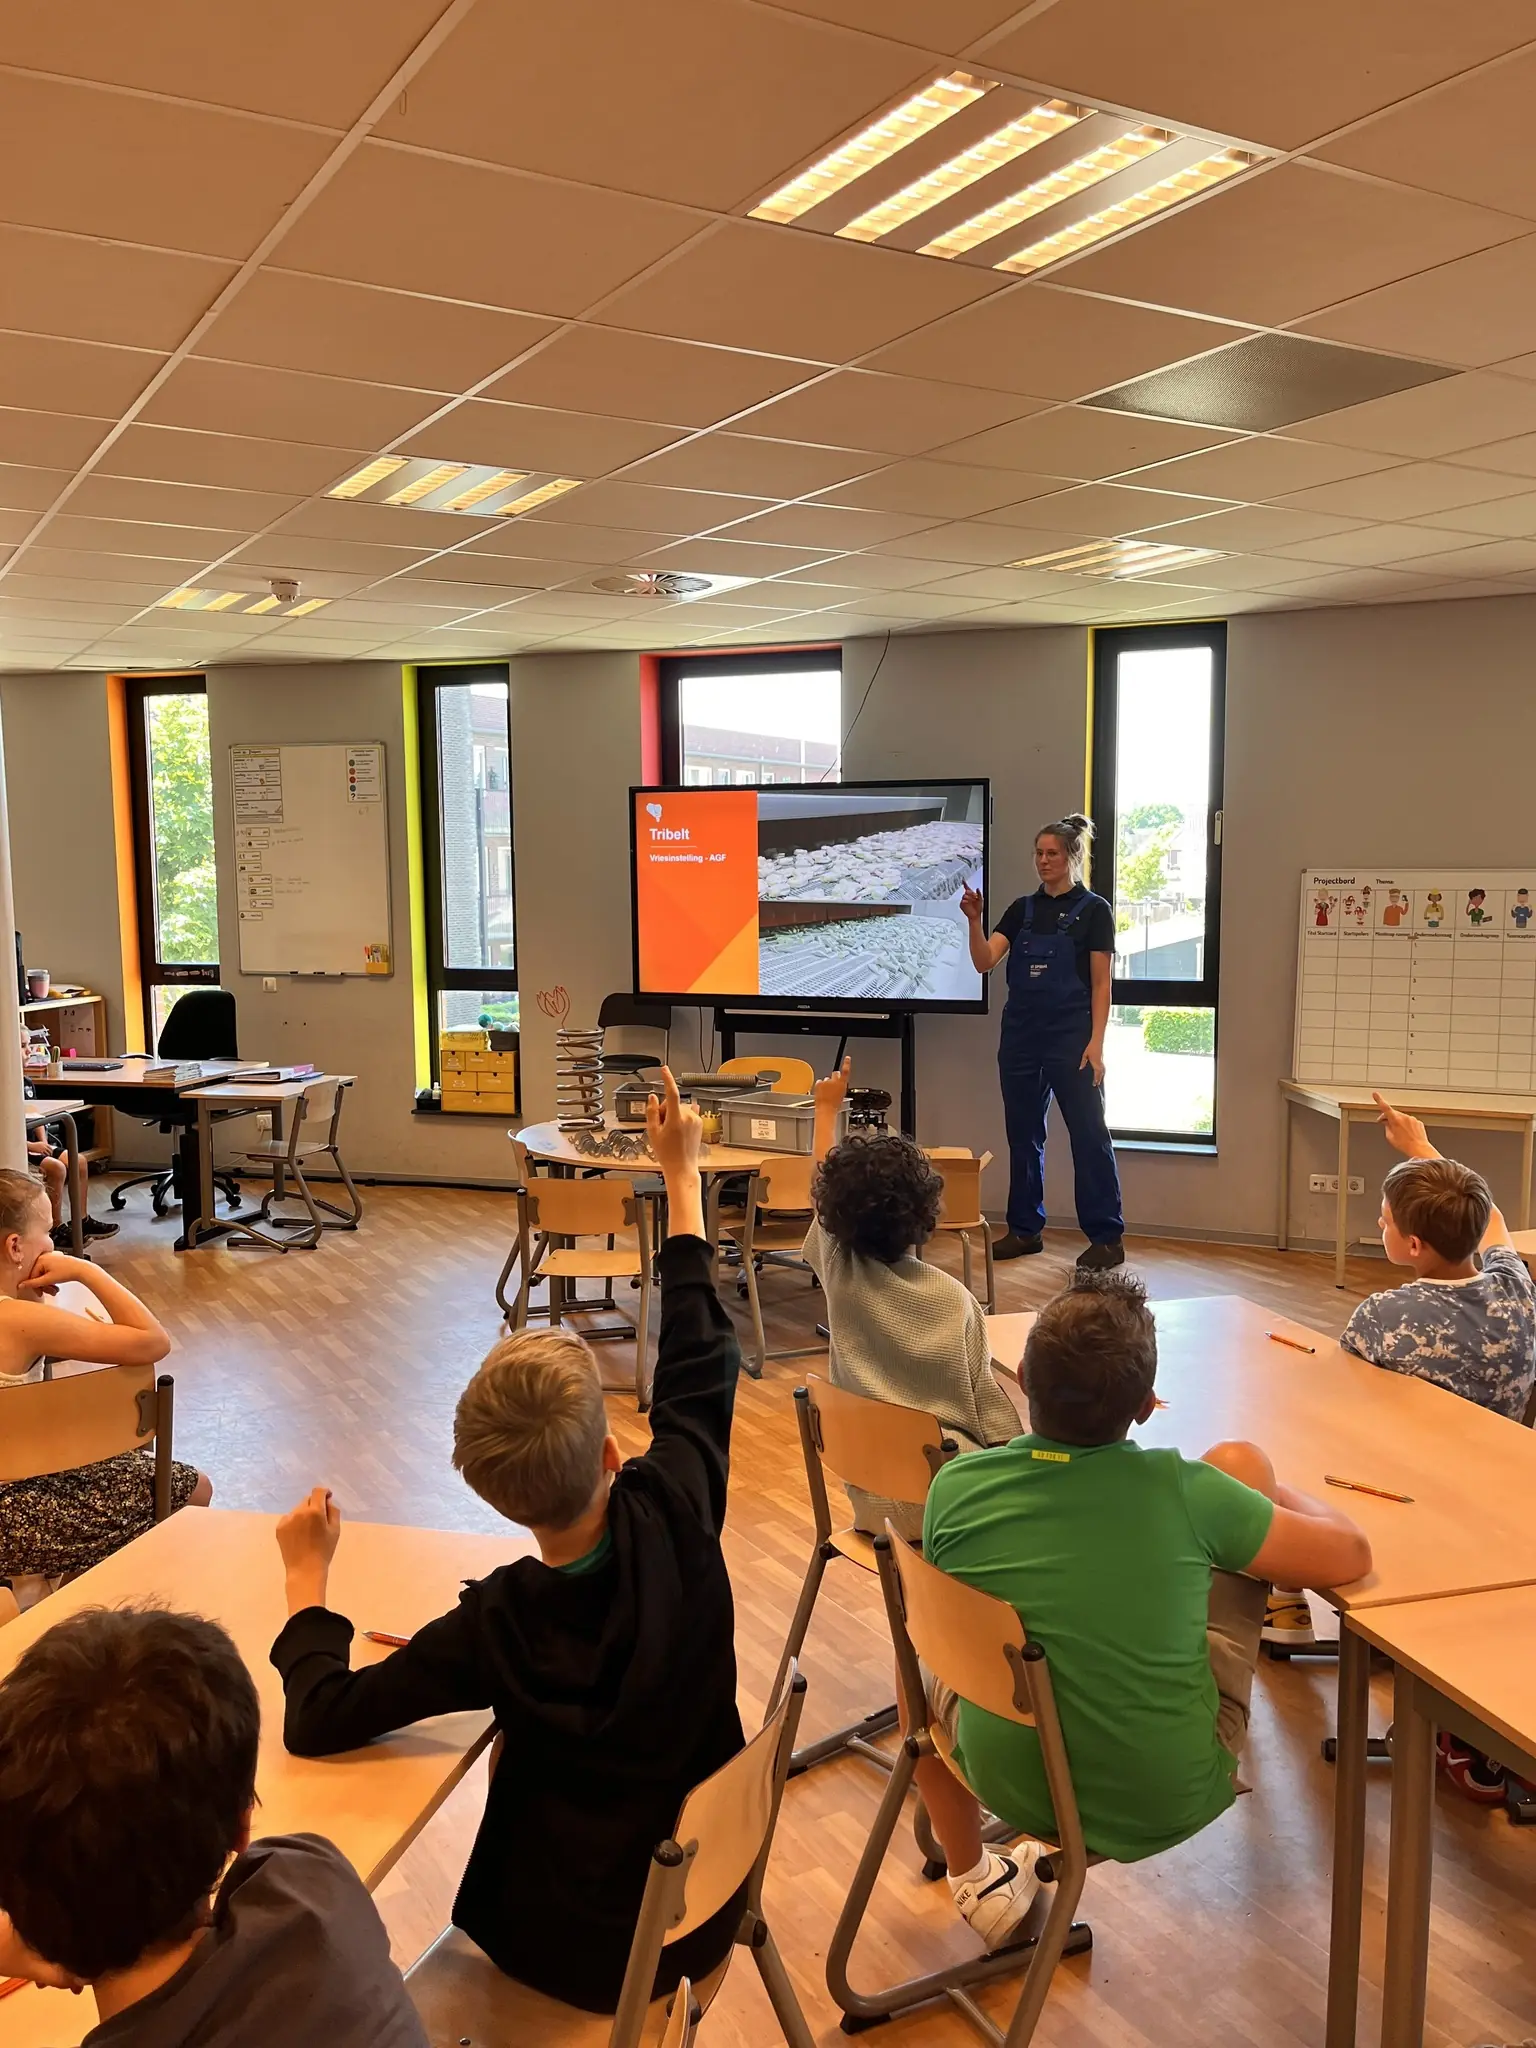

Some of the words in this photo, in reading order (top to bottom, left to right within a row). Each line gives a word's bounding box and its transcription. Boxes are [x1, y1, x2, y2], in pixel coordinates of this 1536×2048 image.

[649, 828, 690, 841] Tribelt
[649, 853, 704, 863] Vriesinstelling
[709, 853, 727, 862] AGF
[1313, 876, 1356, 886] Projectbord
[956, 1888, 972, 1907] NIKE
